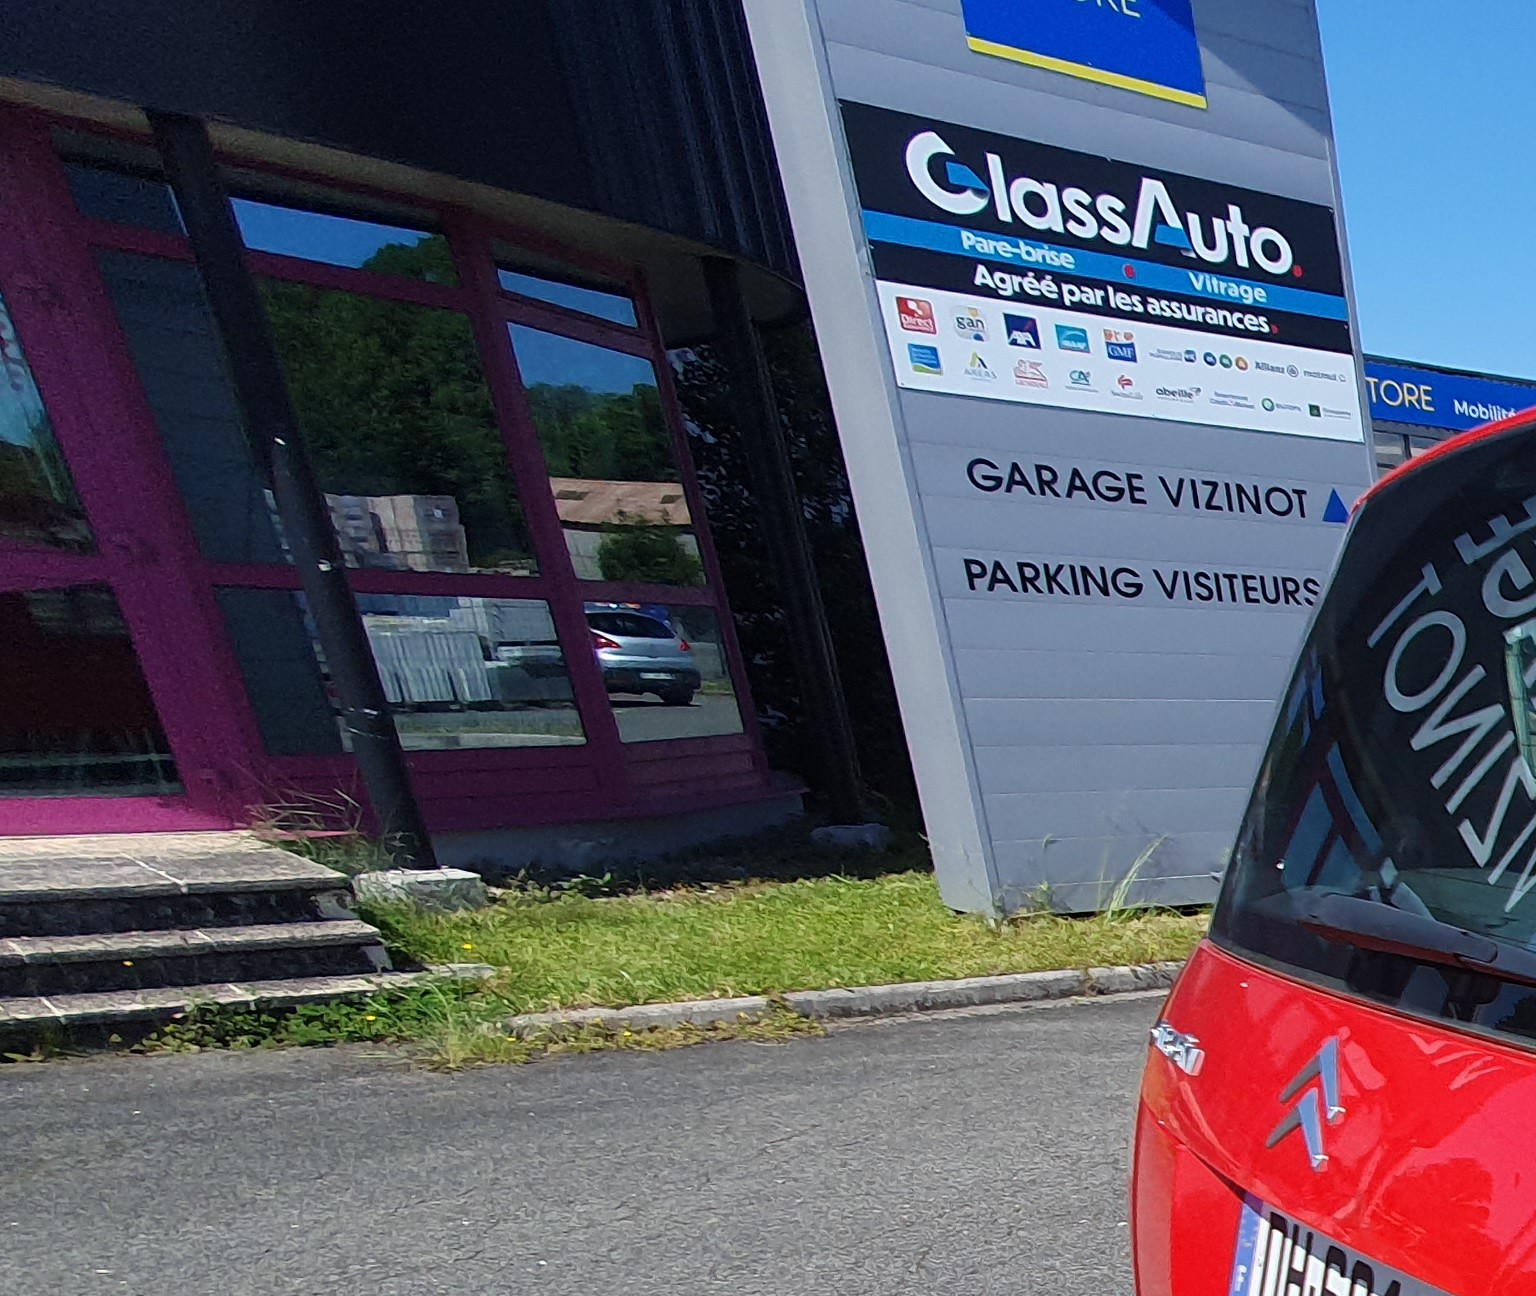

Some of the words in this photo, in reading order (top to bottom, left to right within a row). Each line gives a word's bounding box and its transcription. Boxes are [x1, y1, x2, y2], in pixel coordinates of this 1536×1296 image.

[960, 229, 1075, 270] Pare-brise
[1188, 271, 1267, 304] Vitrage
[973, 263, 1059, 300] Agréé
[1061, 281, 1105, 308] par
[1106, 284, 1144, 314] les
[956, 316, 985, 330] gan
[1008, 330, 1037, 347] AXA
[1108, 344, 1135, 359] GMF
[1155, 386, 1194, 400] abeille
[966, 457, 1148, 506] GARAGE
[1158, 475, 1308, 519] VIZINOT
[963, 557, 1144, 599] PARKING
[1152, 568, 1321, 607] VISITEURS
